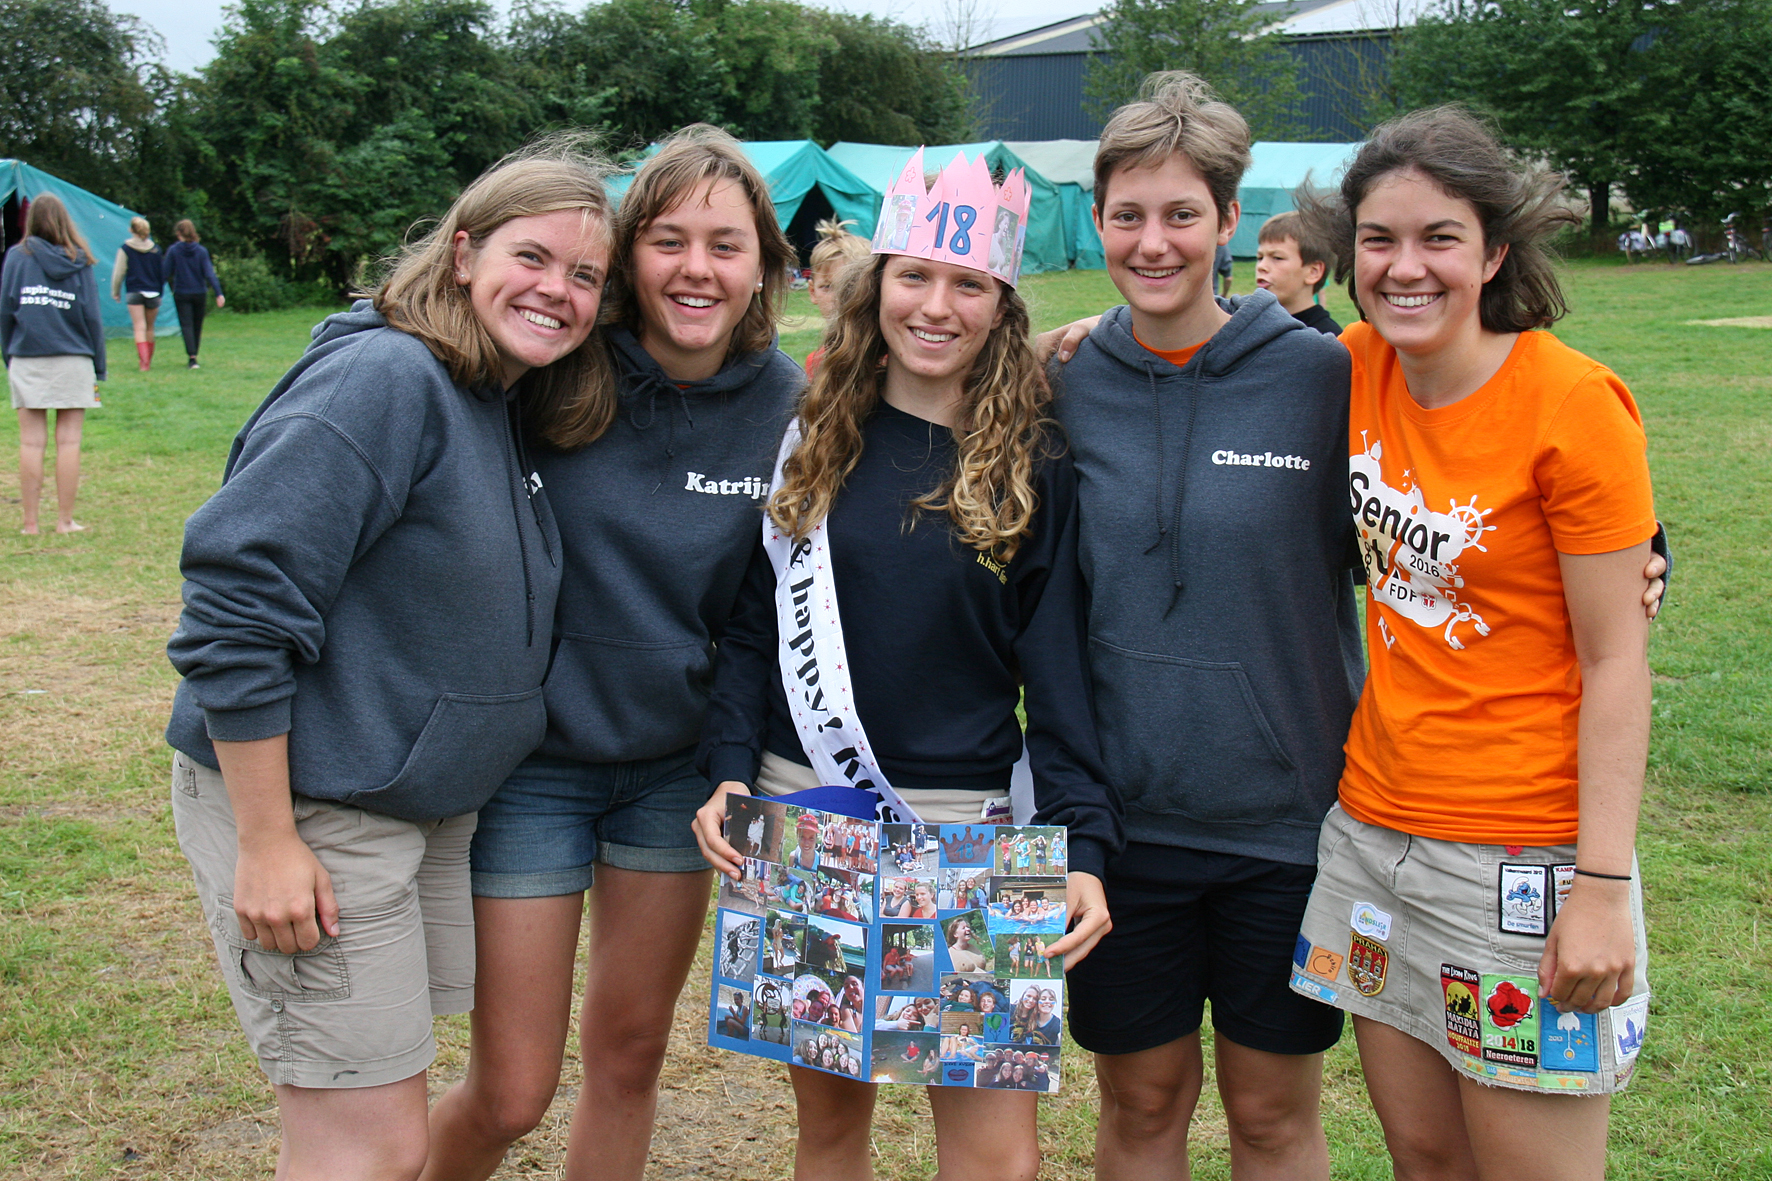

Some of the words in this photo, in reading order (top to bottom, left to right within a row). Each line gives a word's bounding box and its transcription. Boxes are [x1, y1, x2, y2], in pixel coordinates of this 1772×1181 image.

[925, 201, 977, 256] 18
[1211, 449, 1311, 471] Charlotte
[1350, 471, 1450, 561] Senior
[1409, 554, 1440, 578] 2016
[1389, 583, 1418, 602] FDF
[787, 572, 843, 734] happy!
[1353, 935, 1385, 956] PRAHA
[1295, 977, 1322, 996] LIER
[1520, 1038, 1535, 1052] 18
